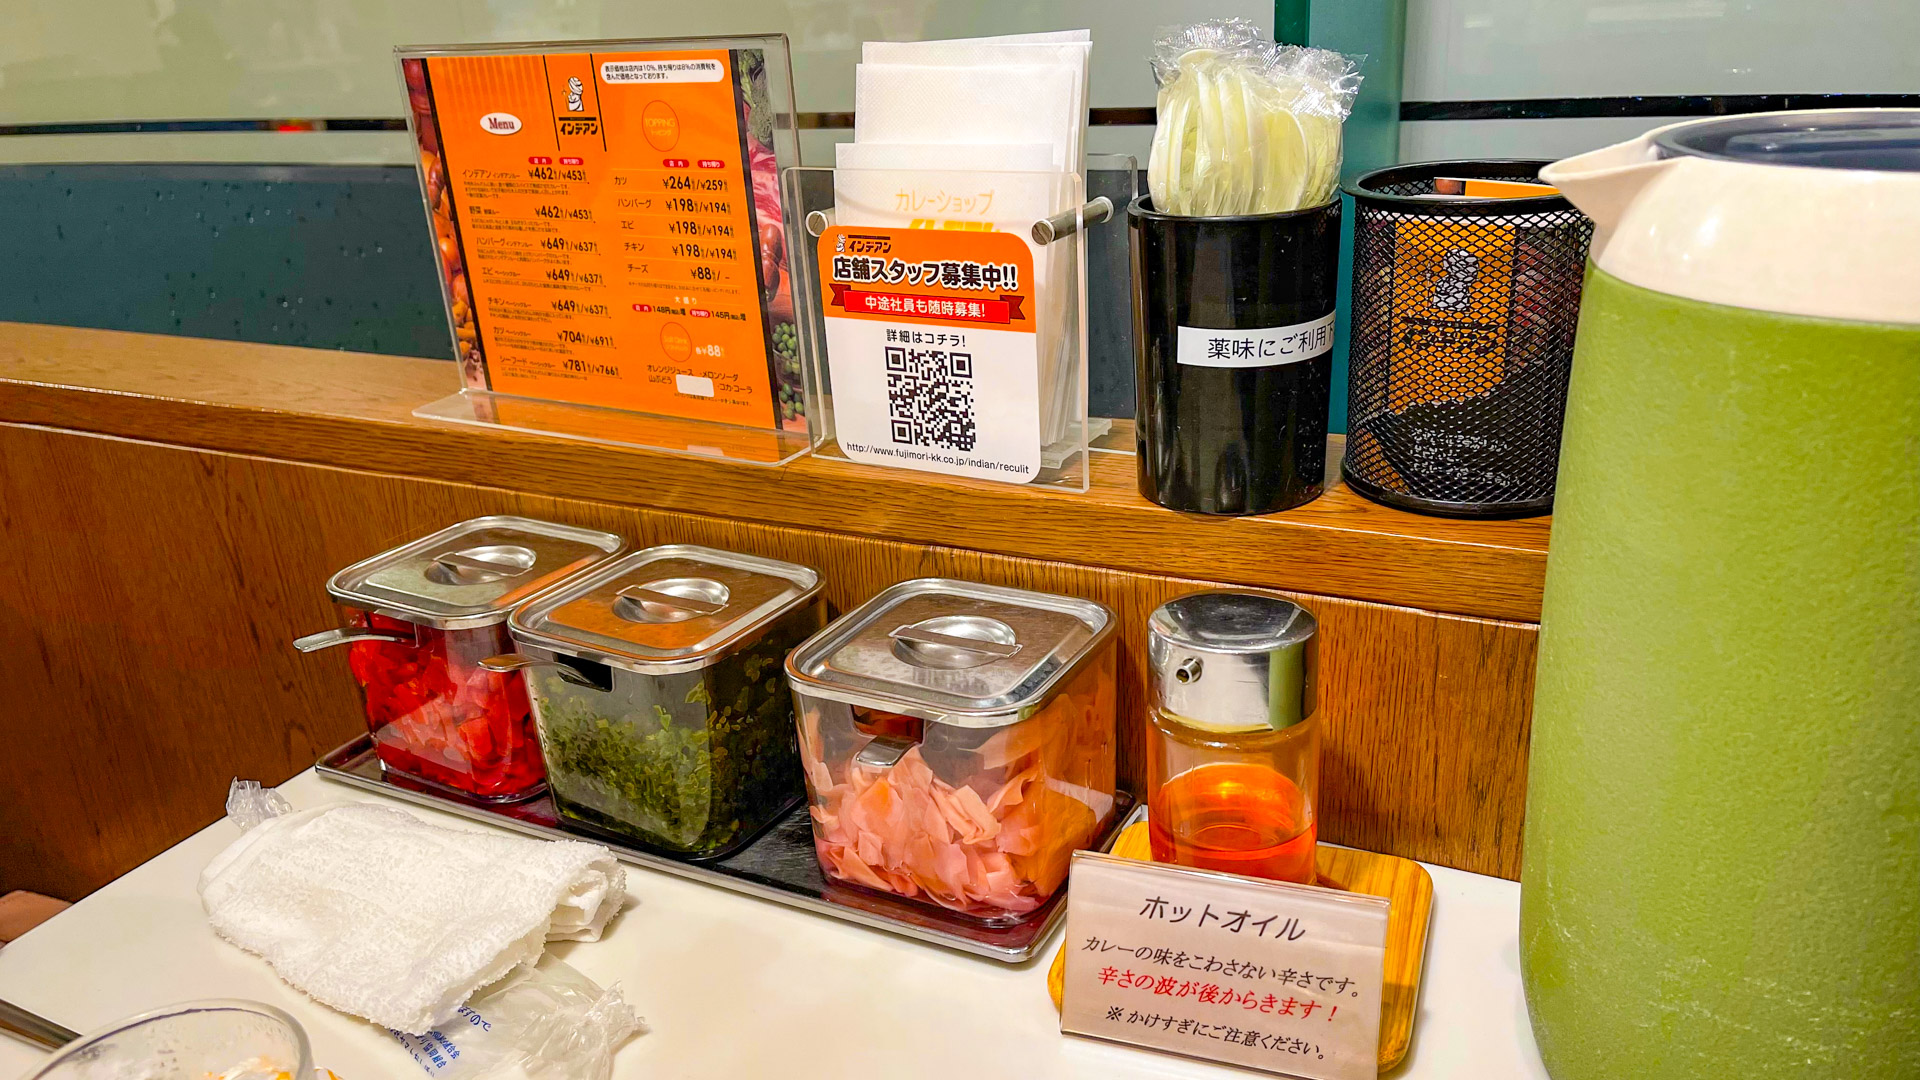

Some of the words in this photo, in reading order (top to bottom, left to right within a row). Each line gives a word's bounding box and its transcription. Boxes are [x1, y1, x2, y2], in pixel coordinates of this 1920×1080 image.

[488, 118, 515, 130] Menu
[560, 122, 599, 135] インデアン
[462, 169, 492, 178] インデアン
[614, 176, 628, 186] カツ
[618, 198, 652, 208] ハンバーグ
[621, 220, 635, 229] エビ
[476, 236, 506, 246] ハンバーグ
[624, 242, 645, 252] チキン
[849, 240, 892, 254] インデアン
[481, 266, 494, 276] エビ
[627, 263, 649, 274] チーズ
[488, 296, 505, 305] チキン
[865, 296, 986, 318] 中途社員も随時募集!
[493, 326, 504, 335] カツ
[886, 329, 967, 347] 詳細はコチラ!
[500, 356, 528, 364] シーフード
[847, 442, 1030, 474] http://www.fujimori-kk.co.jp/indian/reculit
[1139, 895, 1306, 942] ホットオイル
[1081, 936, 1360, 998] カレーの味をこわさない辛さです。
